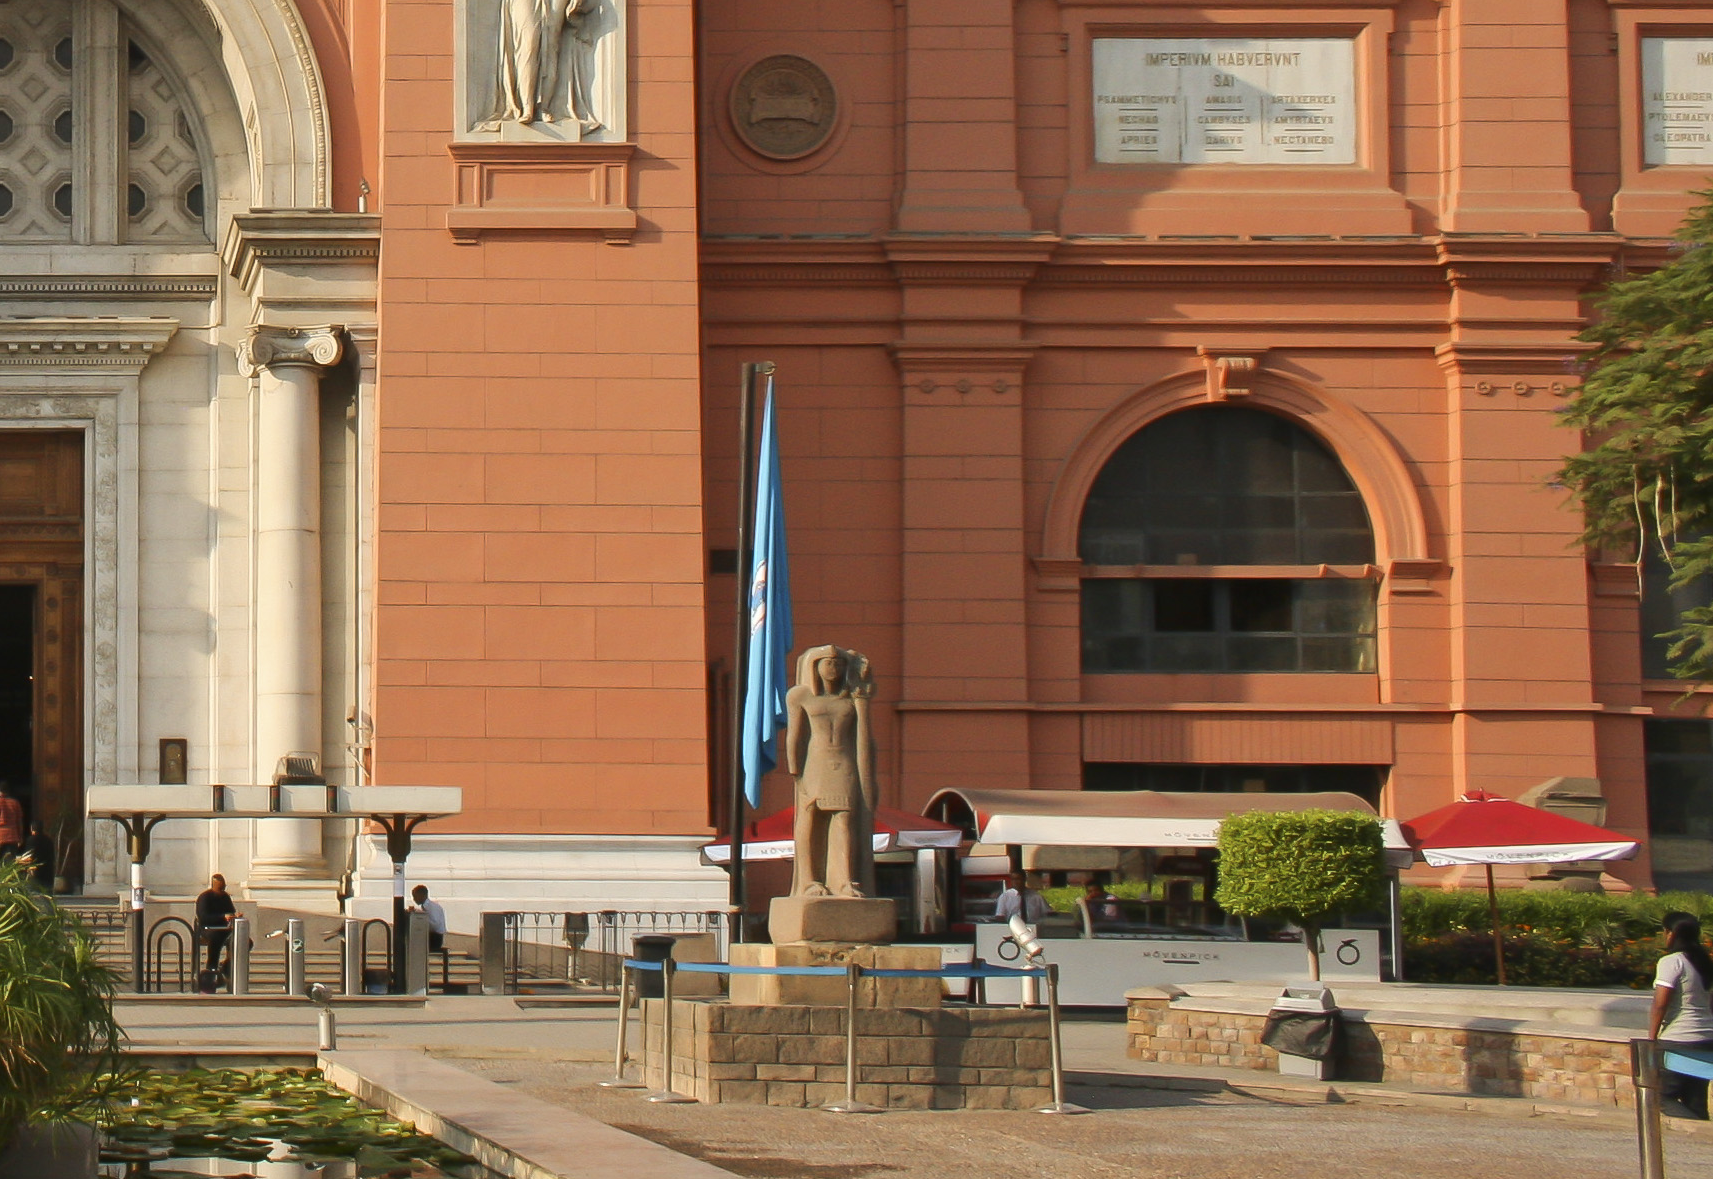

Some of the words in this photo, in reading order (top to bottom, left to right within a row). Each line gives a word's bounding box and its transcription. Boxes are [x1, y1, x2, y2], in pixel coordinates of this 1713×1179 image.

[1145, 52, 1211, 67] IMPERIVM
[1217, 51, 1301, 67] HABVERVNT
[1213, 73, 1235, 88] SAI
[1653, 91, 1712, 101] ALEXANDER
